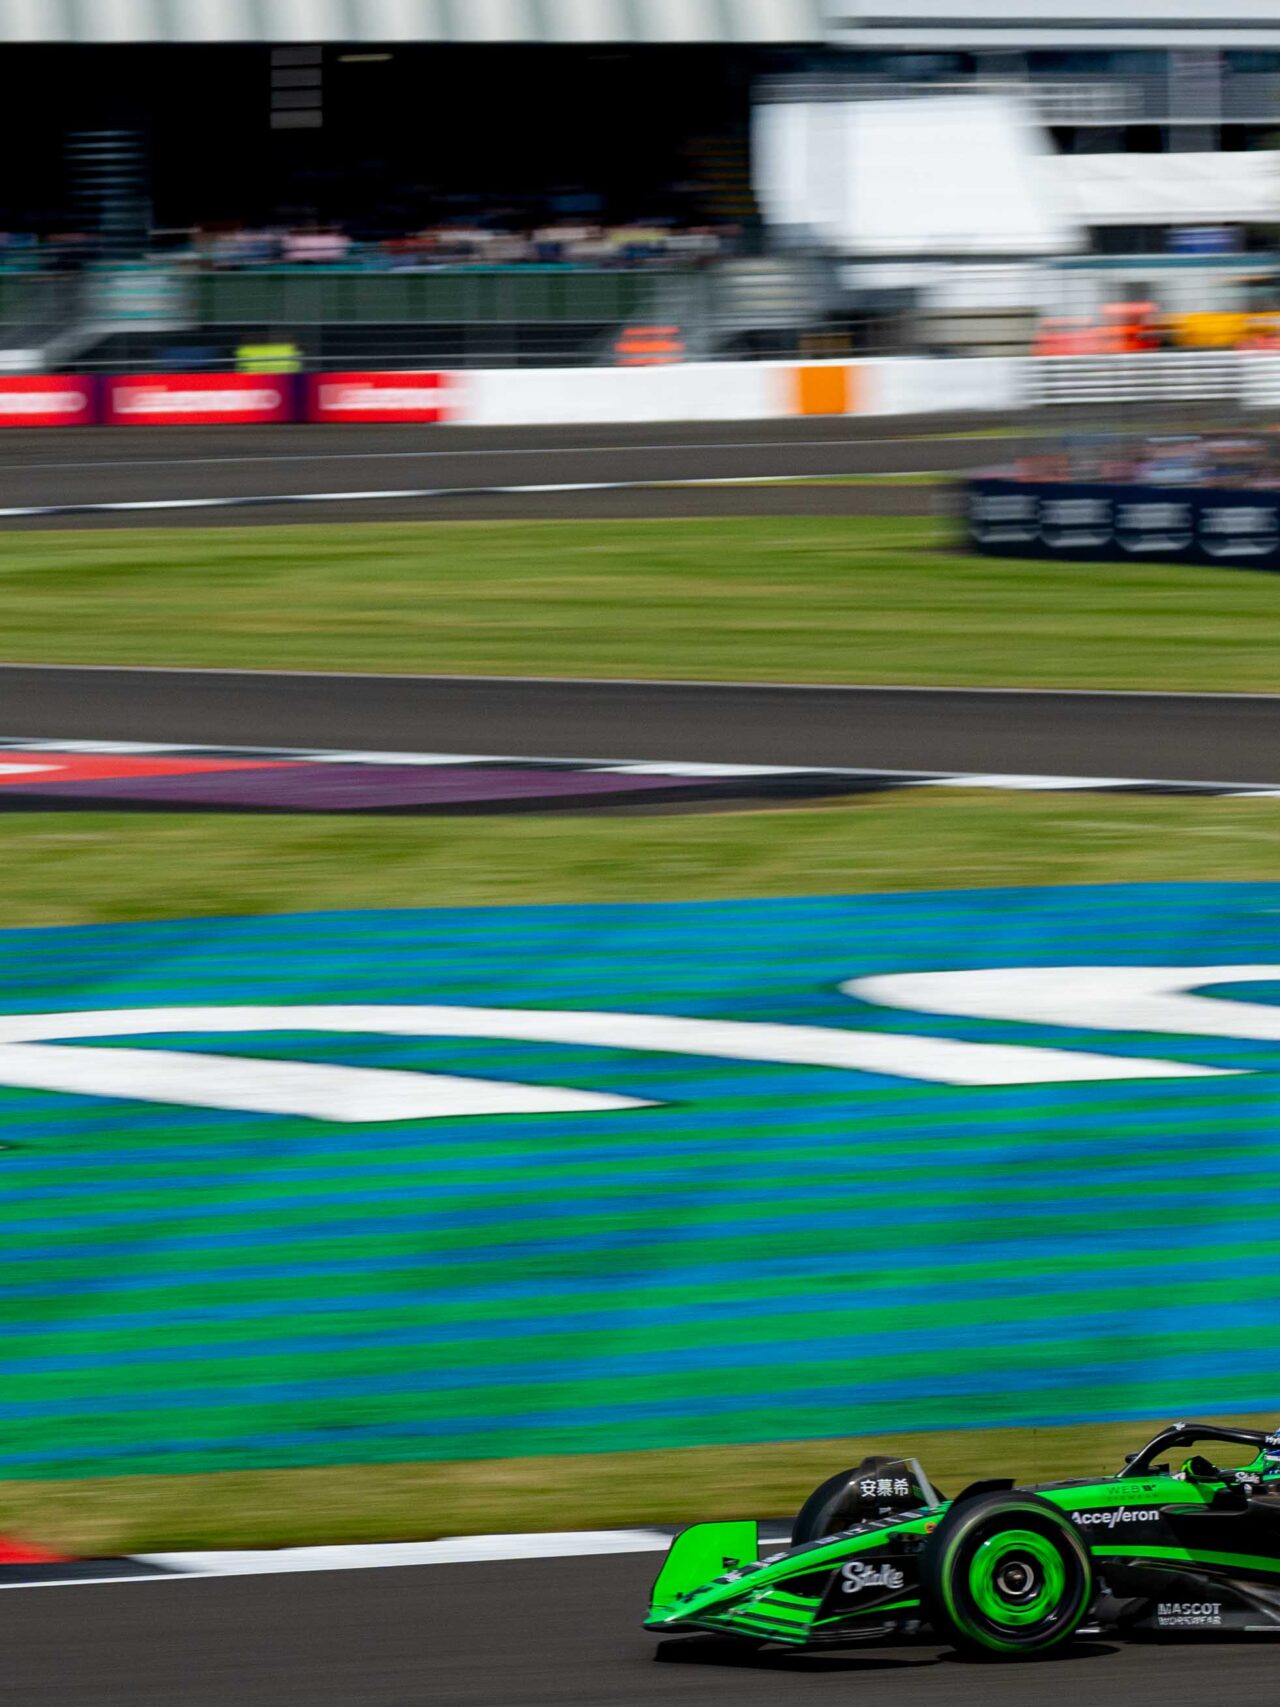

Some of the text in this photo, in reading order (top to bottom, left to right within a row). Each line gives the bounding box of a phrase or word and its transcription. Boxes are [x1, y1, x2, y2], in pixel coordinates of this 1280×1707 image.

[860, 1478, 909, 1497] 安慕希
[1157, 1603, 1222, 1615] MASCOT
